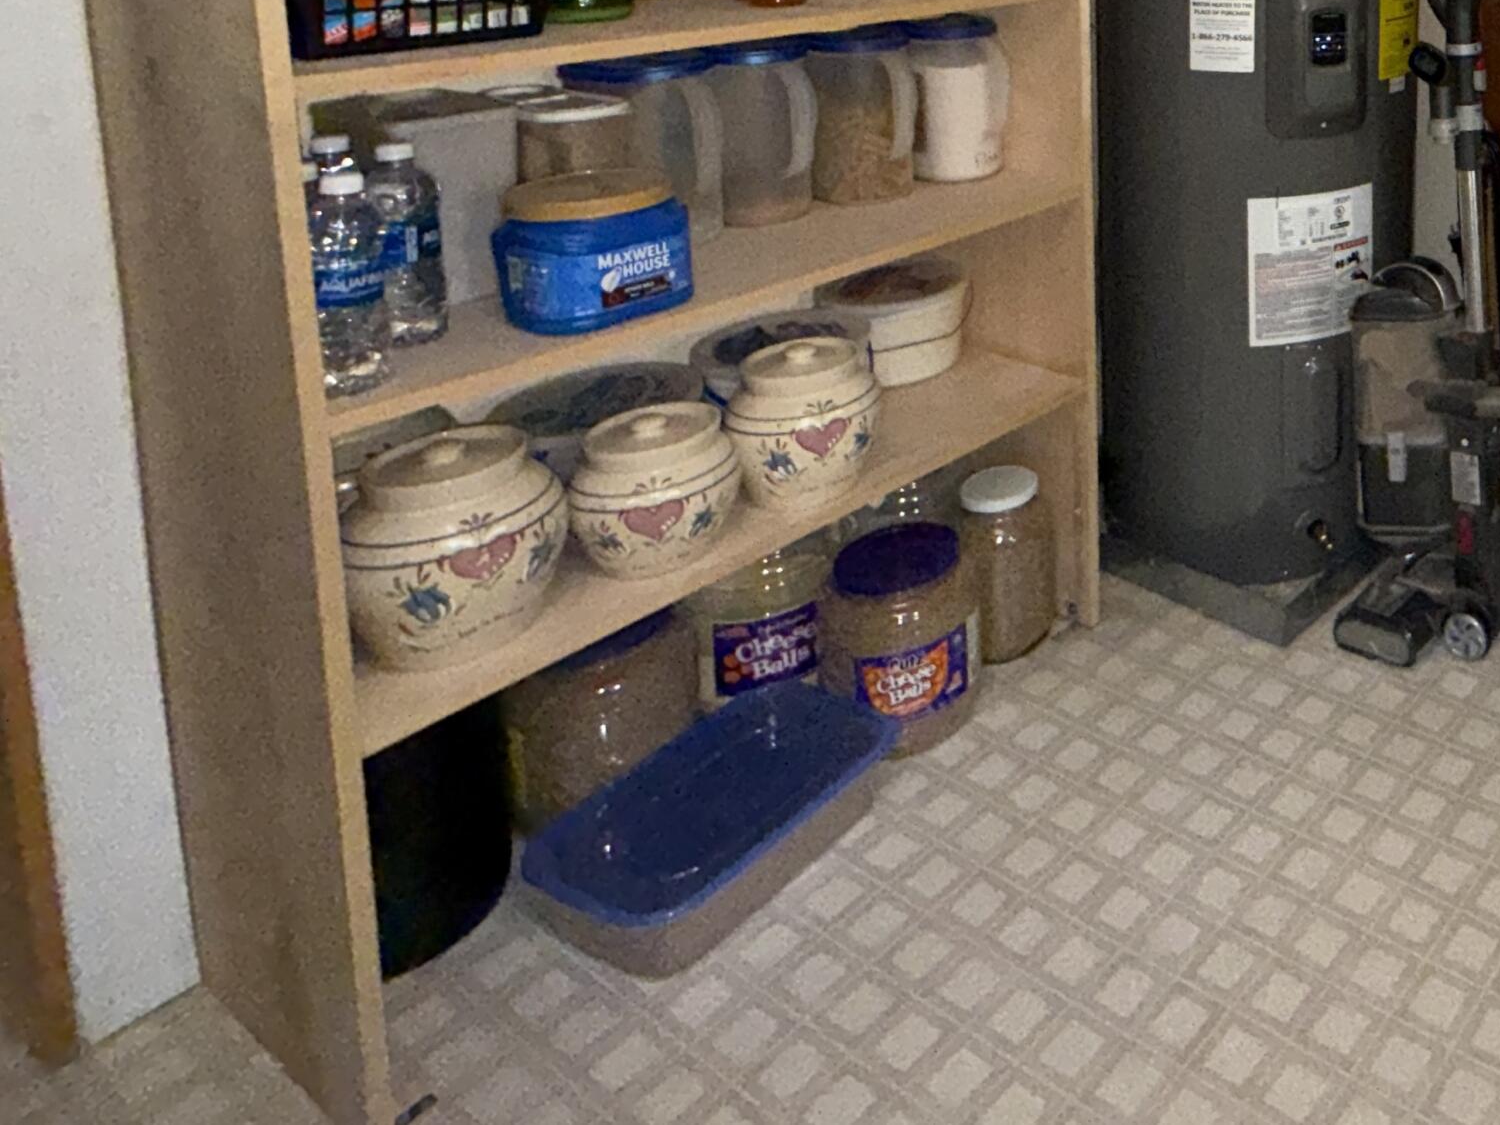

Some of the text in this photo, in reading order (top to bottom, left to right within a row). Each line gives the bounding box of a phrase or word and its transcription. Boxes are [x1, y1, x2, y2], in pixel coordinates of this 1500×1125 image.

[597, 241, 671, 271] MAXWELL
[623, 254, 671, 277] HOUSE
[320, 270, 384, 293] AQUAFI
[735, 621, 817, 663] Cheese
[752, 645, 810, 680] Balls
[876, 664, 937, 693] Cheese
[889, 680, 932, 706] Balls
